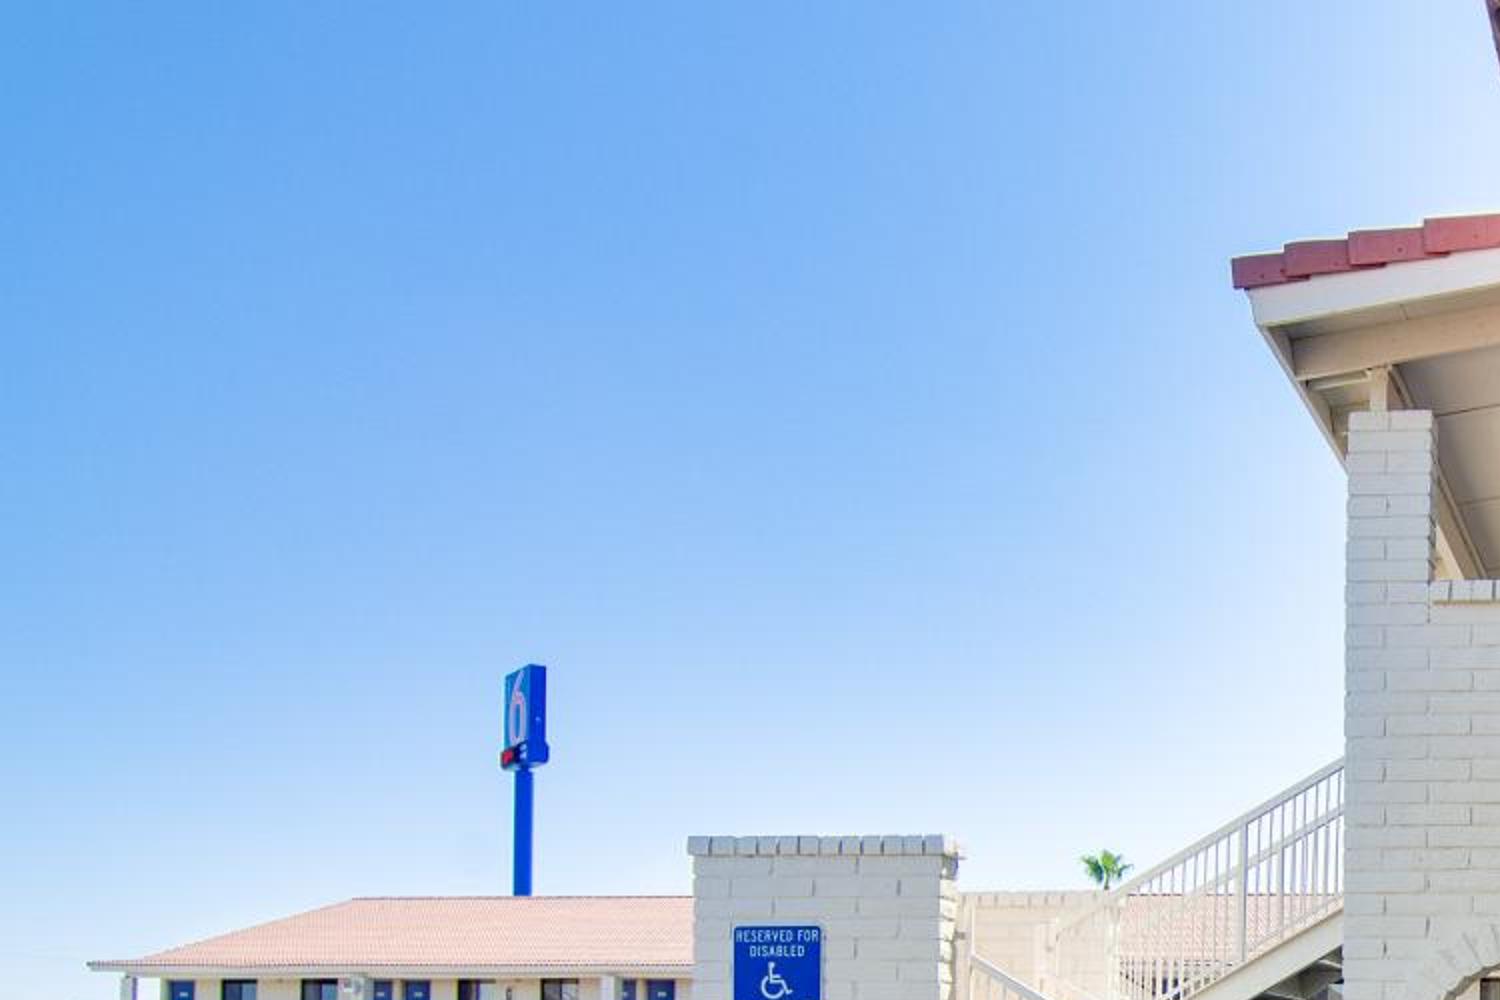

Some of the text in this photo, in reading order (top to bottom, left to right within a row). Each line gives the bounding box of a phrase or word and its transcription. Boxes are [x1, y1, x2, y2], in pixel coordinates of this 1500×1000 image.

[736, 929, 819, 943] RESERVED FOR
[749, 945, 805, 957] DISABLED
